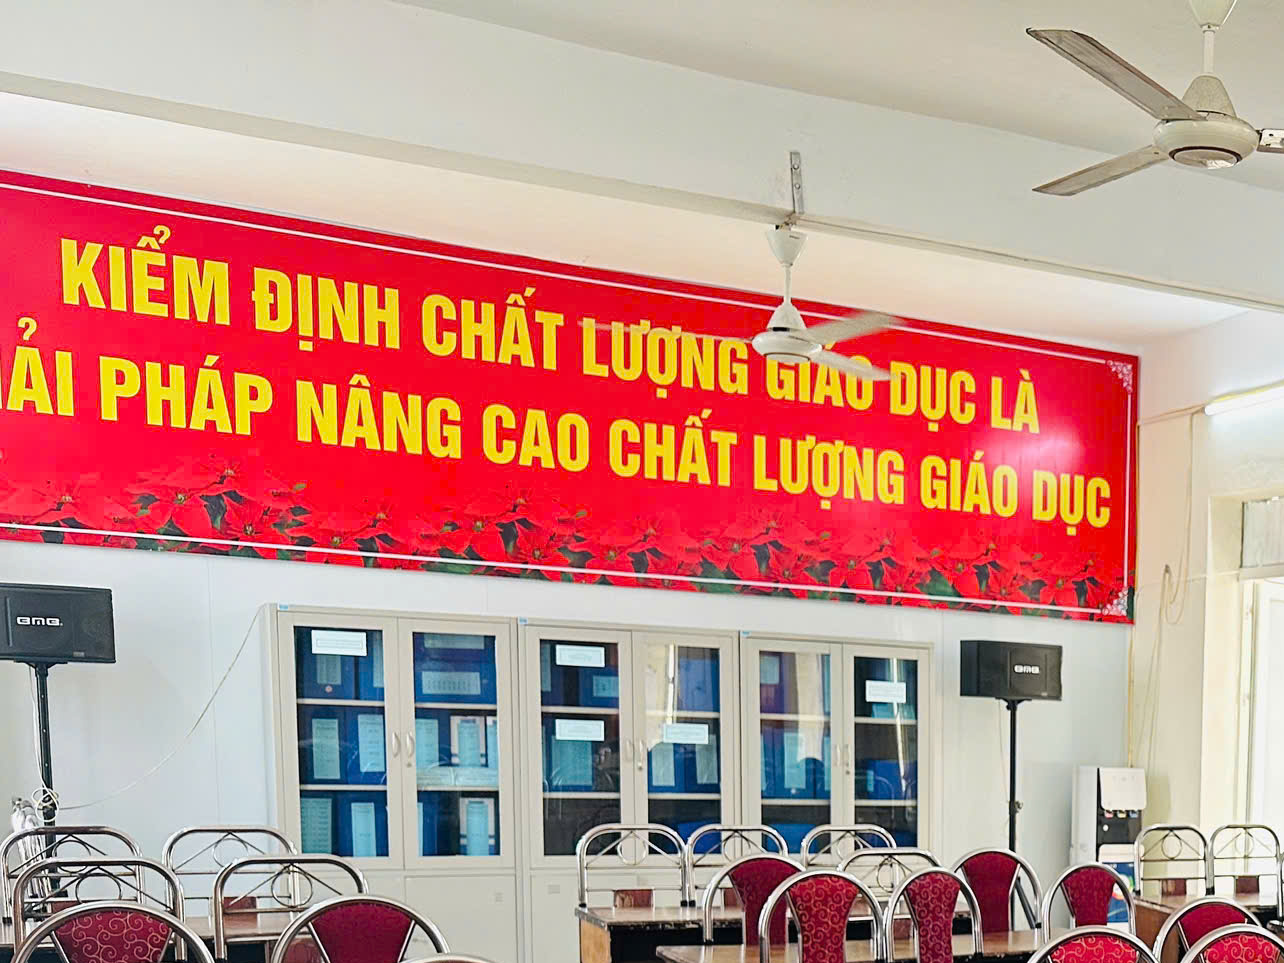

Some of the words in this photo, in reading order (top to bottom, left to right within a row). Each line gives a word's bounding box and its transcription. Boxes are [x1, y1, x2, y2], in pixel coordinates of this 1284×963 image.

[0, 317, 75, 417] ẢI
[99, 355, 273, 435] PHÁP
[296, 374, 461, 459] NÂNG
[482, 404, 589, 472] CAO
[609, 408, 737, 486] CHẤT
[753, 435, 904, 509] LƯỢNG
[921, 452, 1018, 517] GIÁO
[1032, 471, 1110, 535] DỤC
[62, 225, 231, 325] KIỂM
[252, 268, 401, 351] ĐỊNH
[422, 287, 564, 370] CHẤT
[582, 317, 748, 399] LƯỢNG
[889, 360, 976, 432] DỤC
[991, 369, 1039, 433] LÀ
